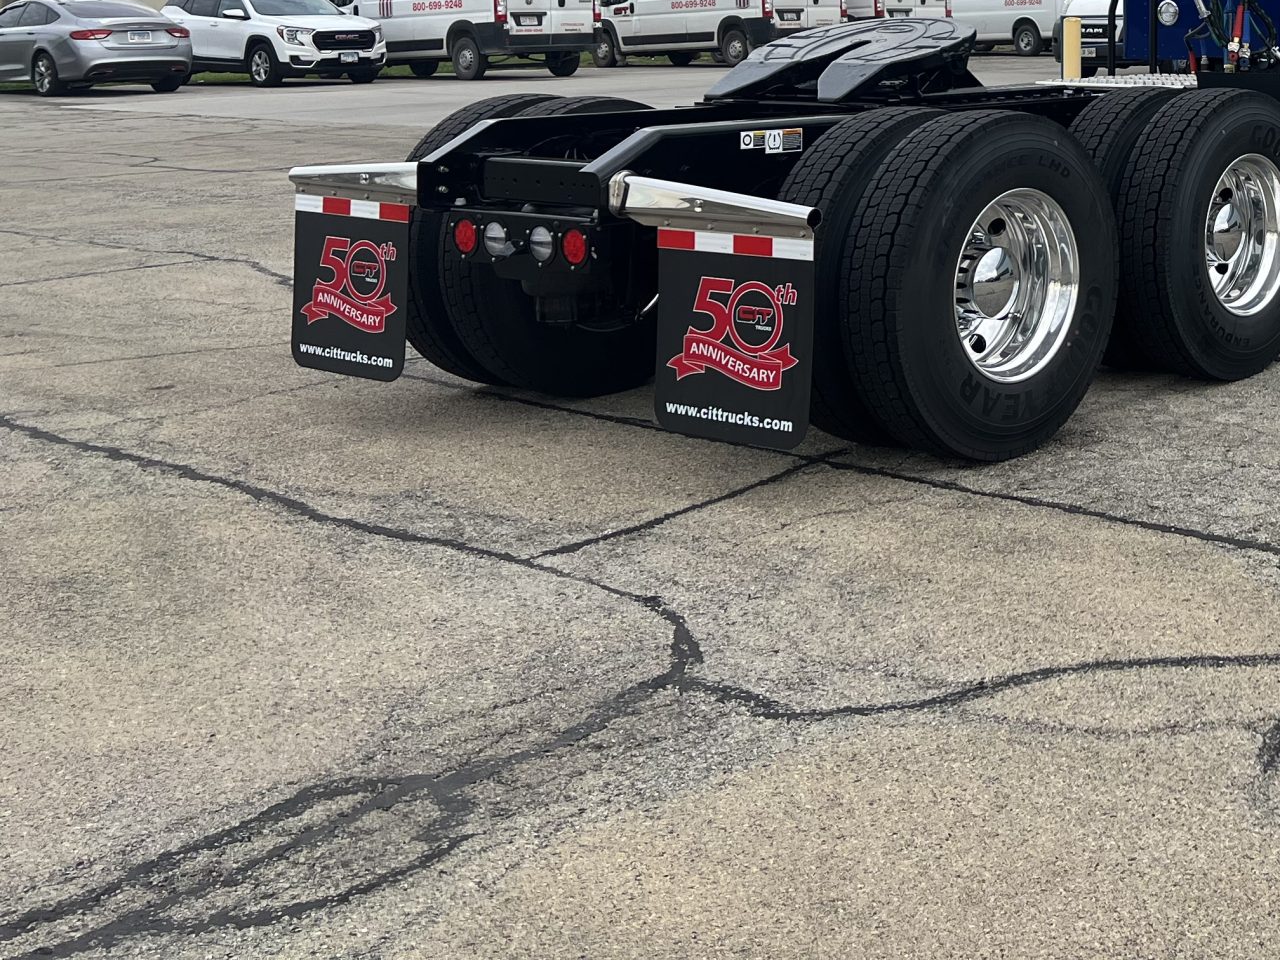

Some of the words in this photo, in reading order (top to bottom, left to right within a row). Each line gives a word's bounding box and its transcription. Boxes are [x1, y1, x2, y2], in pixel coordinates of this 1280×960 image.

[412, 0, 463, 12] 800-699-9248
[317, 292, 381, 327] ANNIVERSARY
[299, 342, 393, 368] www.cittrucks.com
[689, 342, 776, 383] ANNIVERSARY
[665, 402, 793, 432] www.cittrucks.com
